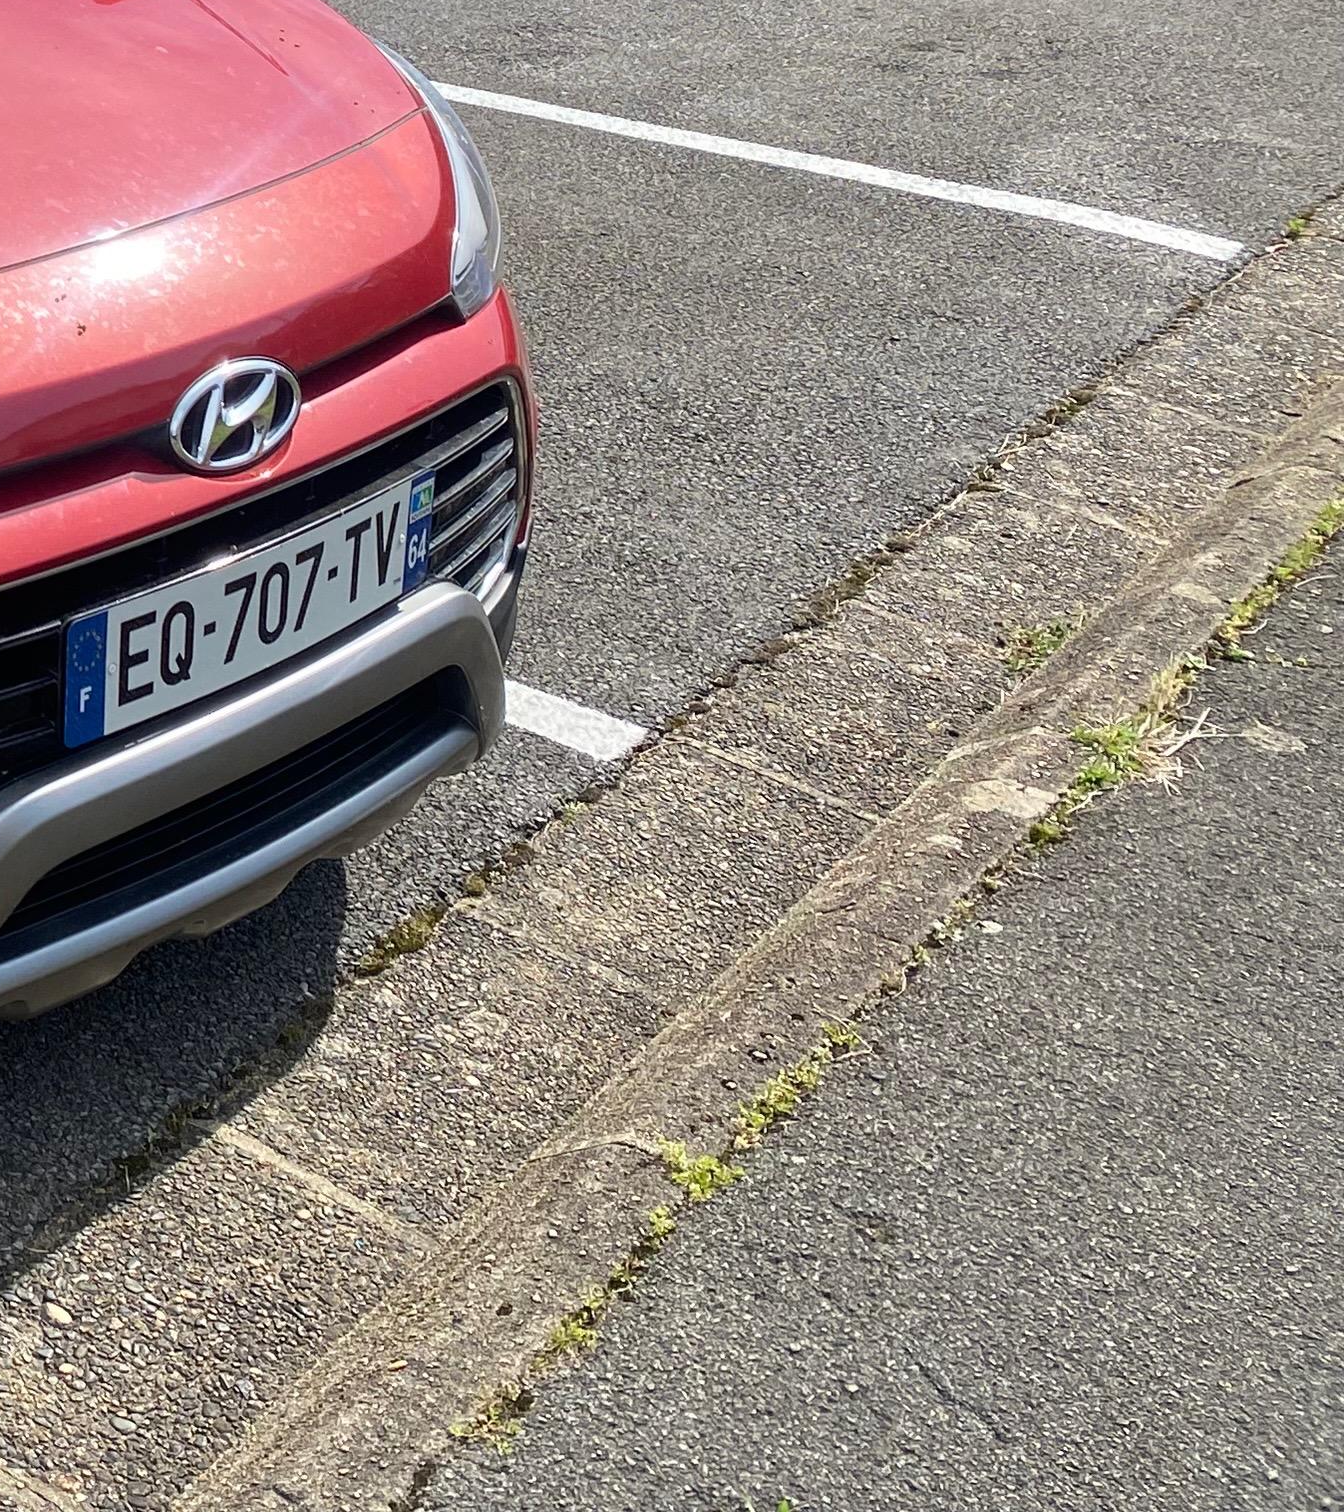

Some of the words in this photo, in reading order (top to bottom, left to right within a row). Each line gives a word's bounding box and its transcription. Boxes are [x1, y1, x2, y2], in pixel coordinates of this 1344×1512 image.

[79, 685, 92, 713] F
[117, 501, 400, 708] EQ-707-TV
[407, 527, 427, 569] 64
